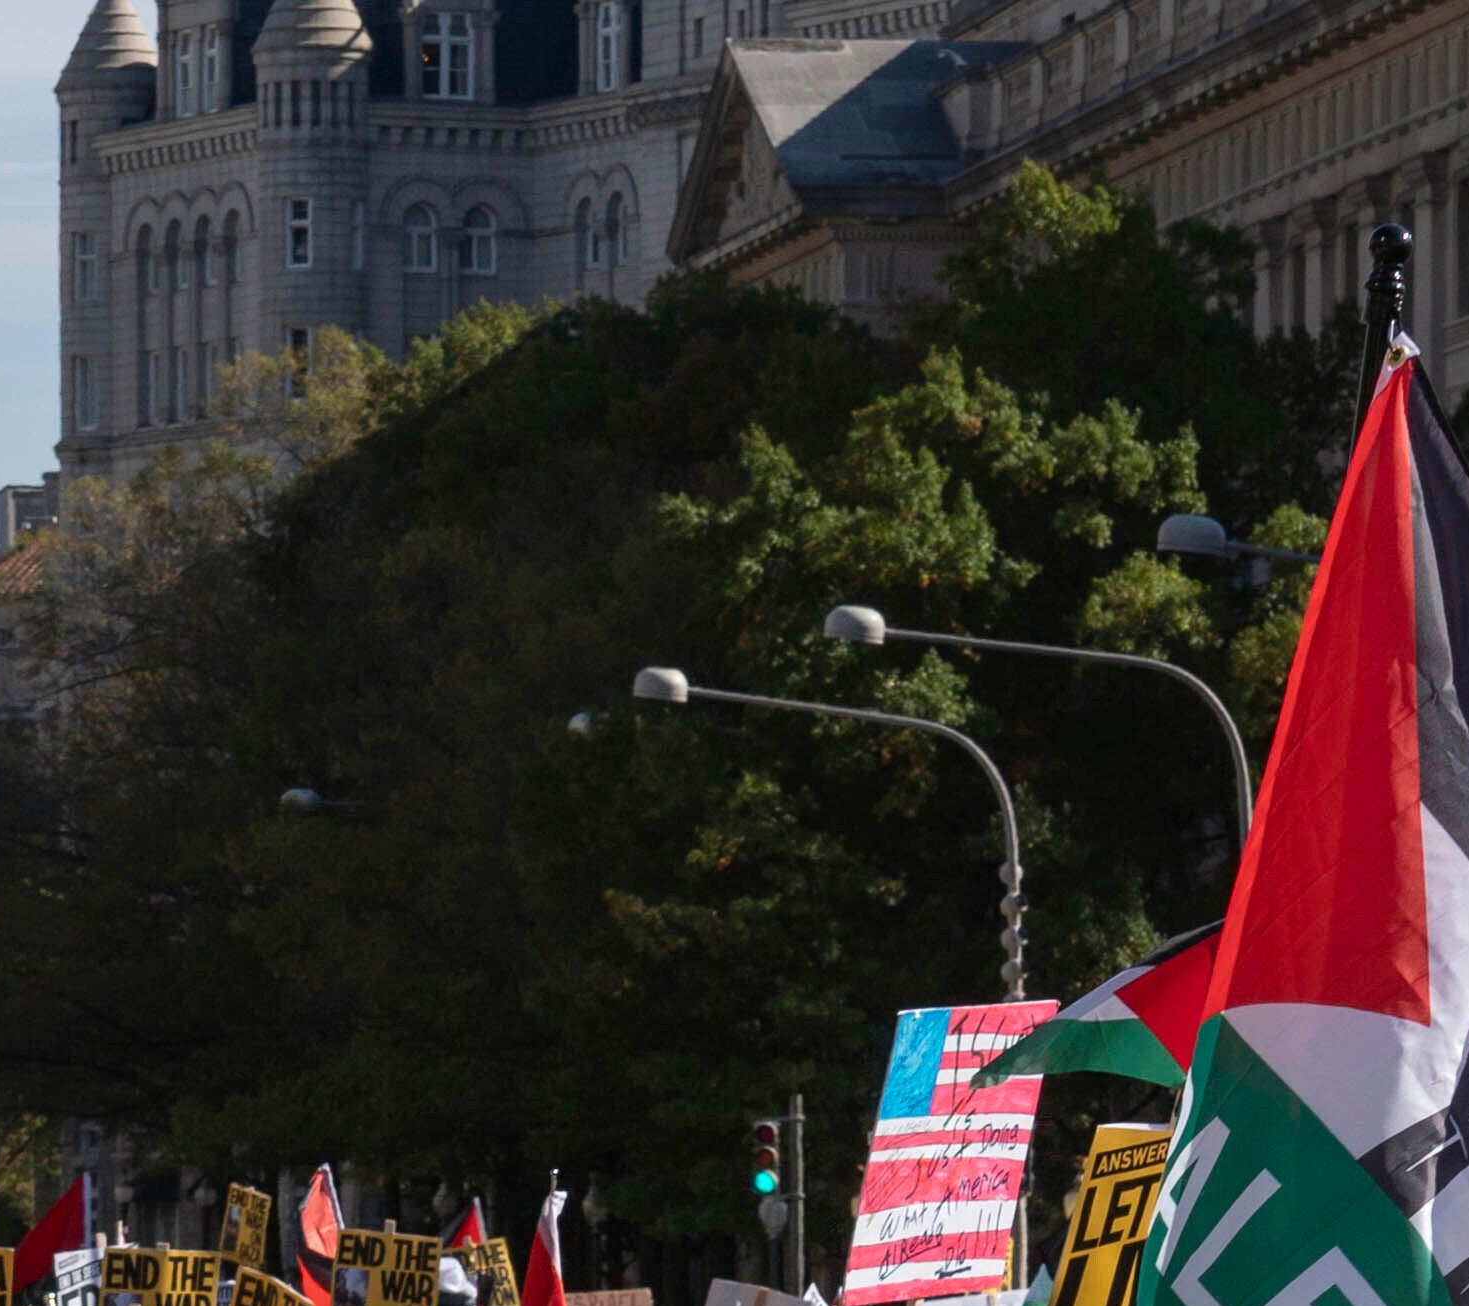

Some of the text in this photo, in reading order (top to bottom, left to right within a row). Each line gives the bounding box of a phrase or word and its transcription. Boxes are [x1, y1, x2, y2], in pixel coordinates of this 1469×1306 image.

[109, 1253, 215, 1291] END THE
[380, 1271, 434, 1304] WAR
